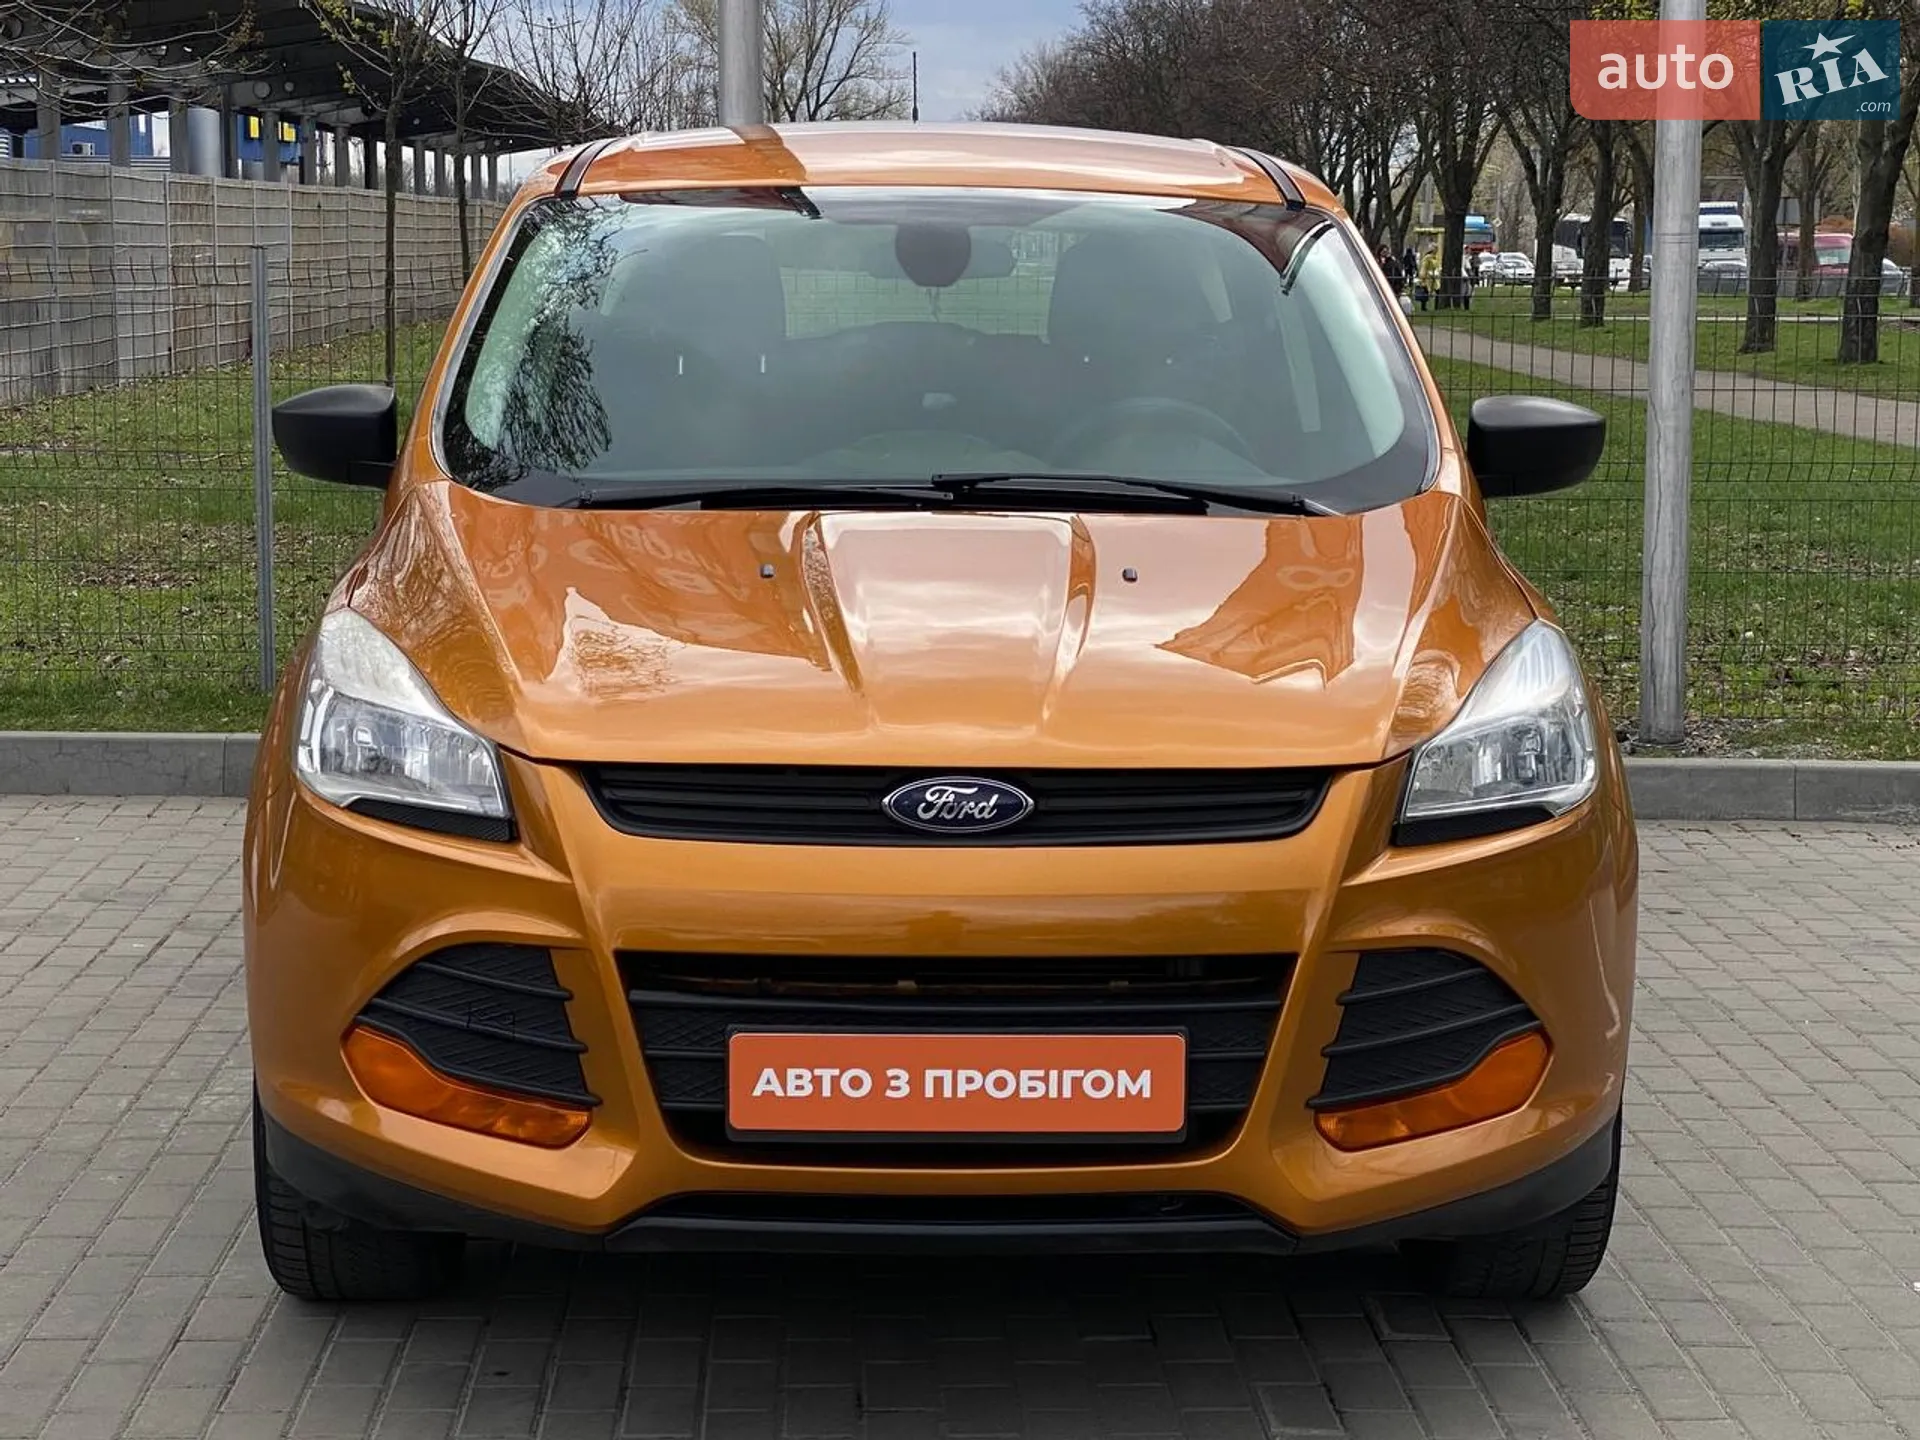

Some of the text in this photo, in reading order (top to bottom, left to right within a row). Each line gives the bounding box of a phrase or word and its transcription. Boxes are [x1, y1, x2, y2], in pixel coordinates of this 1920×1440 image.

[916, 785, 999, 820] Ford
[752, 1068, 1152, 1099] АВТО З ПРОБІГОМ
